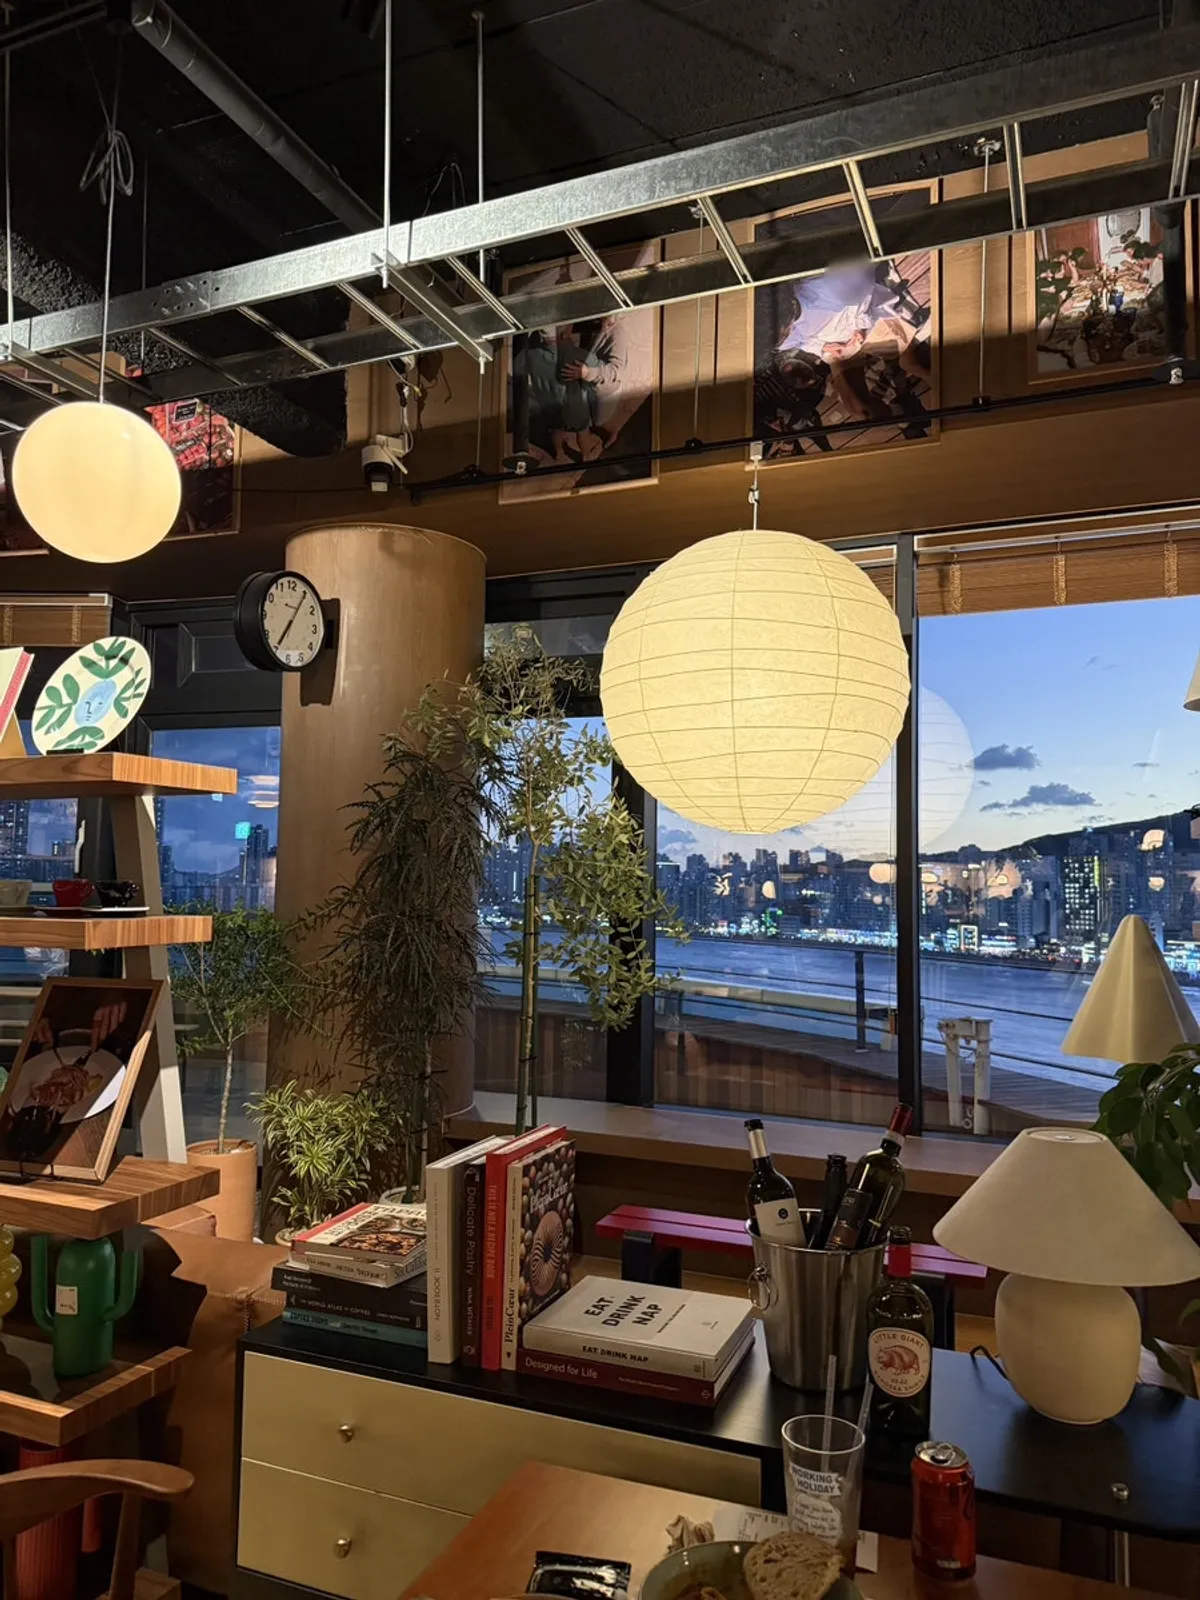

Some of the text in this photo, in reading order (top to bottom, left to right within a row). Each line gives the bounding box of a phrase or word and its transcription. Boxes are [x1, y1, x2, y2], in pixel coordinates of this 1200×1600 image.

[287, 580, 297, 592] 12
[309, 605, 316, 616] 2
[311, 624, 318, 635] 3
[307, 641, 314, 652] 4
[285, 653, 292, 664] 6
[297, 652, 304, 663] 5
[466, 1186, 477, 1237] Delicate
[585, 1296, 614, 1317] EAT
[601, 1295, 645, 1327] DRINK
[632, 1303, 662, 1326] NAP
[873, 1332, 925, 1349] LITTLE GIANT
[582, 1345, 649, 1363] EAT DRINK NAP
[525, 1356, 598, 1379] Designed for Life
[792, 1466, 833, 1484] WORKING
[797, 1478, 835, 1493] HOLIDAY
